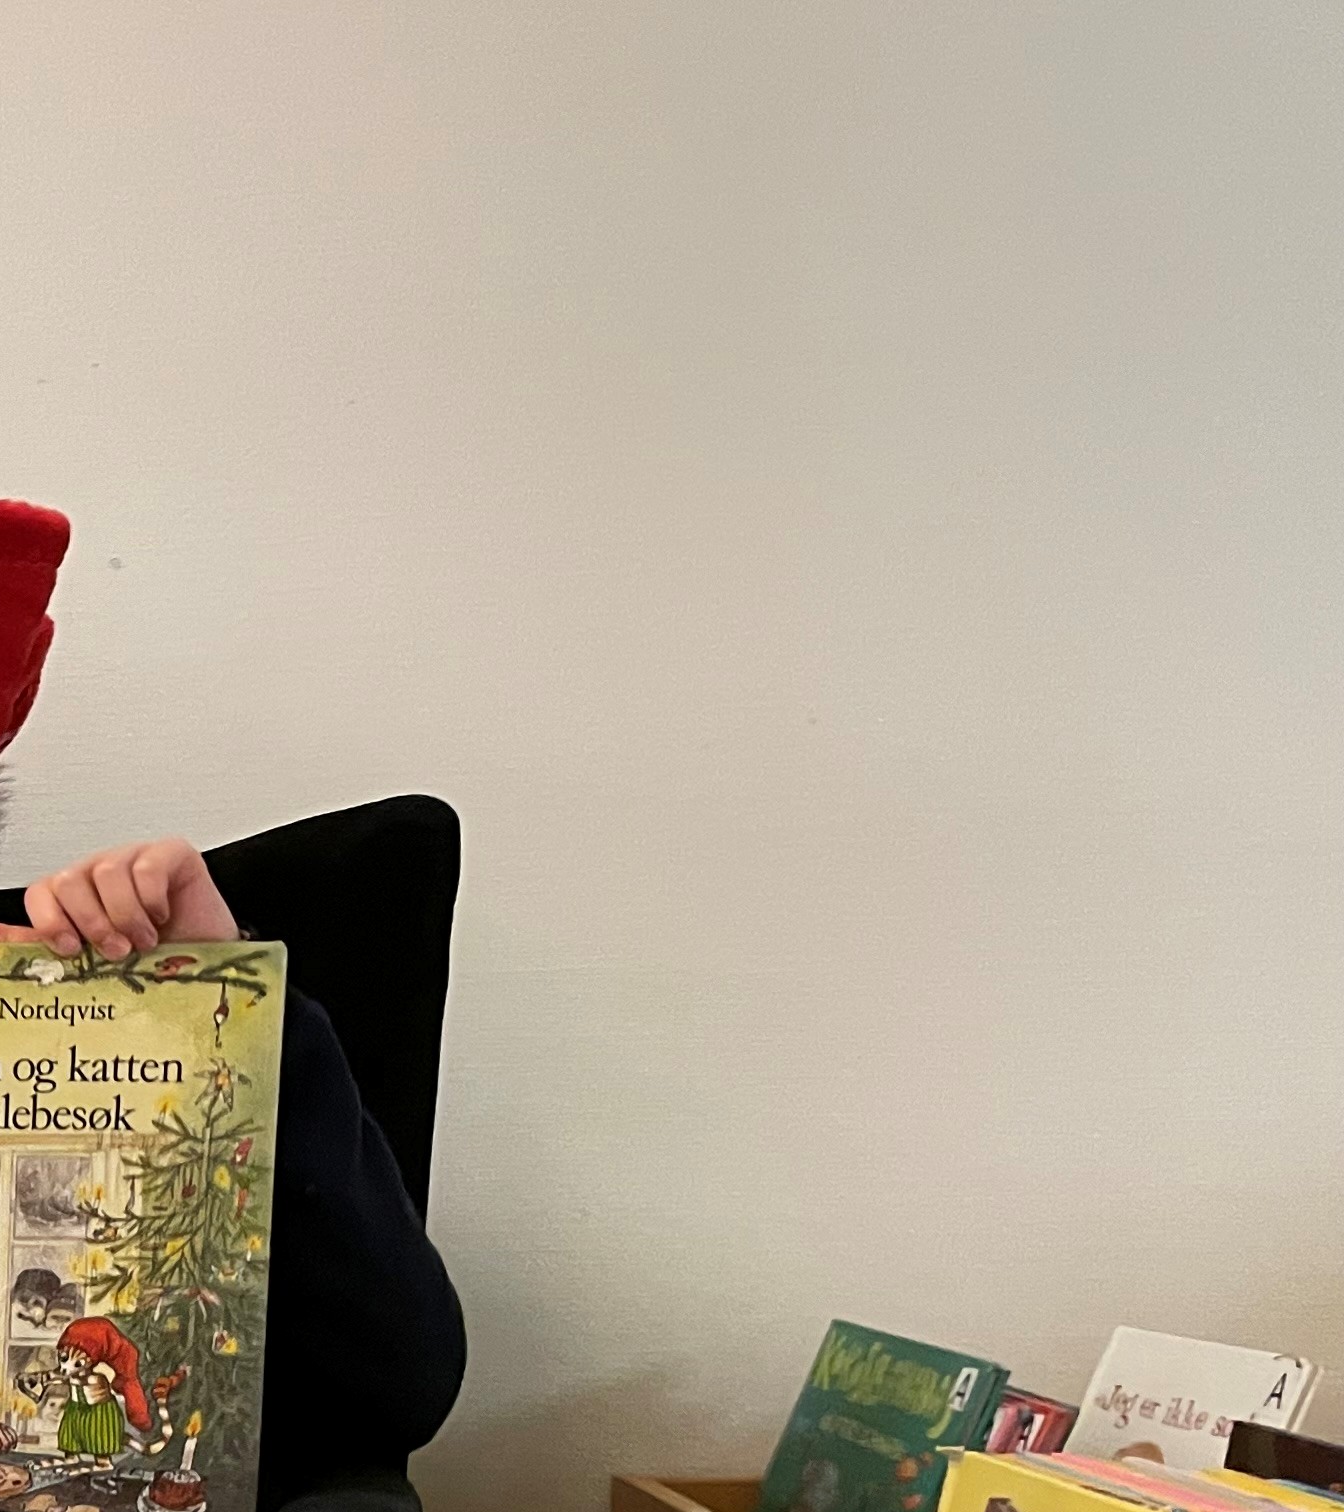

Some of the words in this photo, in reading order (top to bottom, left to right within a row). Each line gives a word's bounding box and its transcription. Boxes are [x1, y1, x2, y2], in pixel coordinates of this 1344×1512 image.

[12, 1056, 58, 1094] og
[67, 1045, 184, 1083] katten
[1264, 1372, 1288, 1410] A
[1162, 1397, 1209, 1431] ikke
[1211, 1415, 1235, 1438] so
